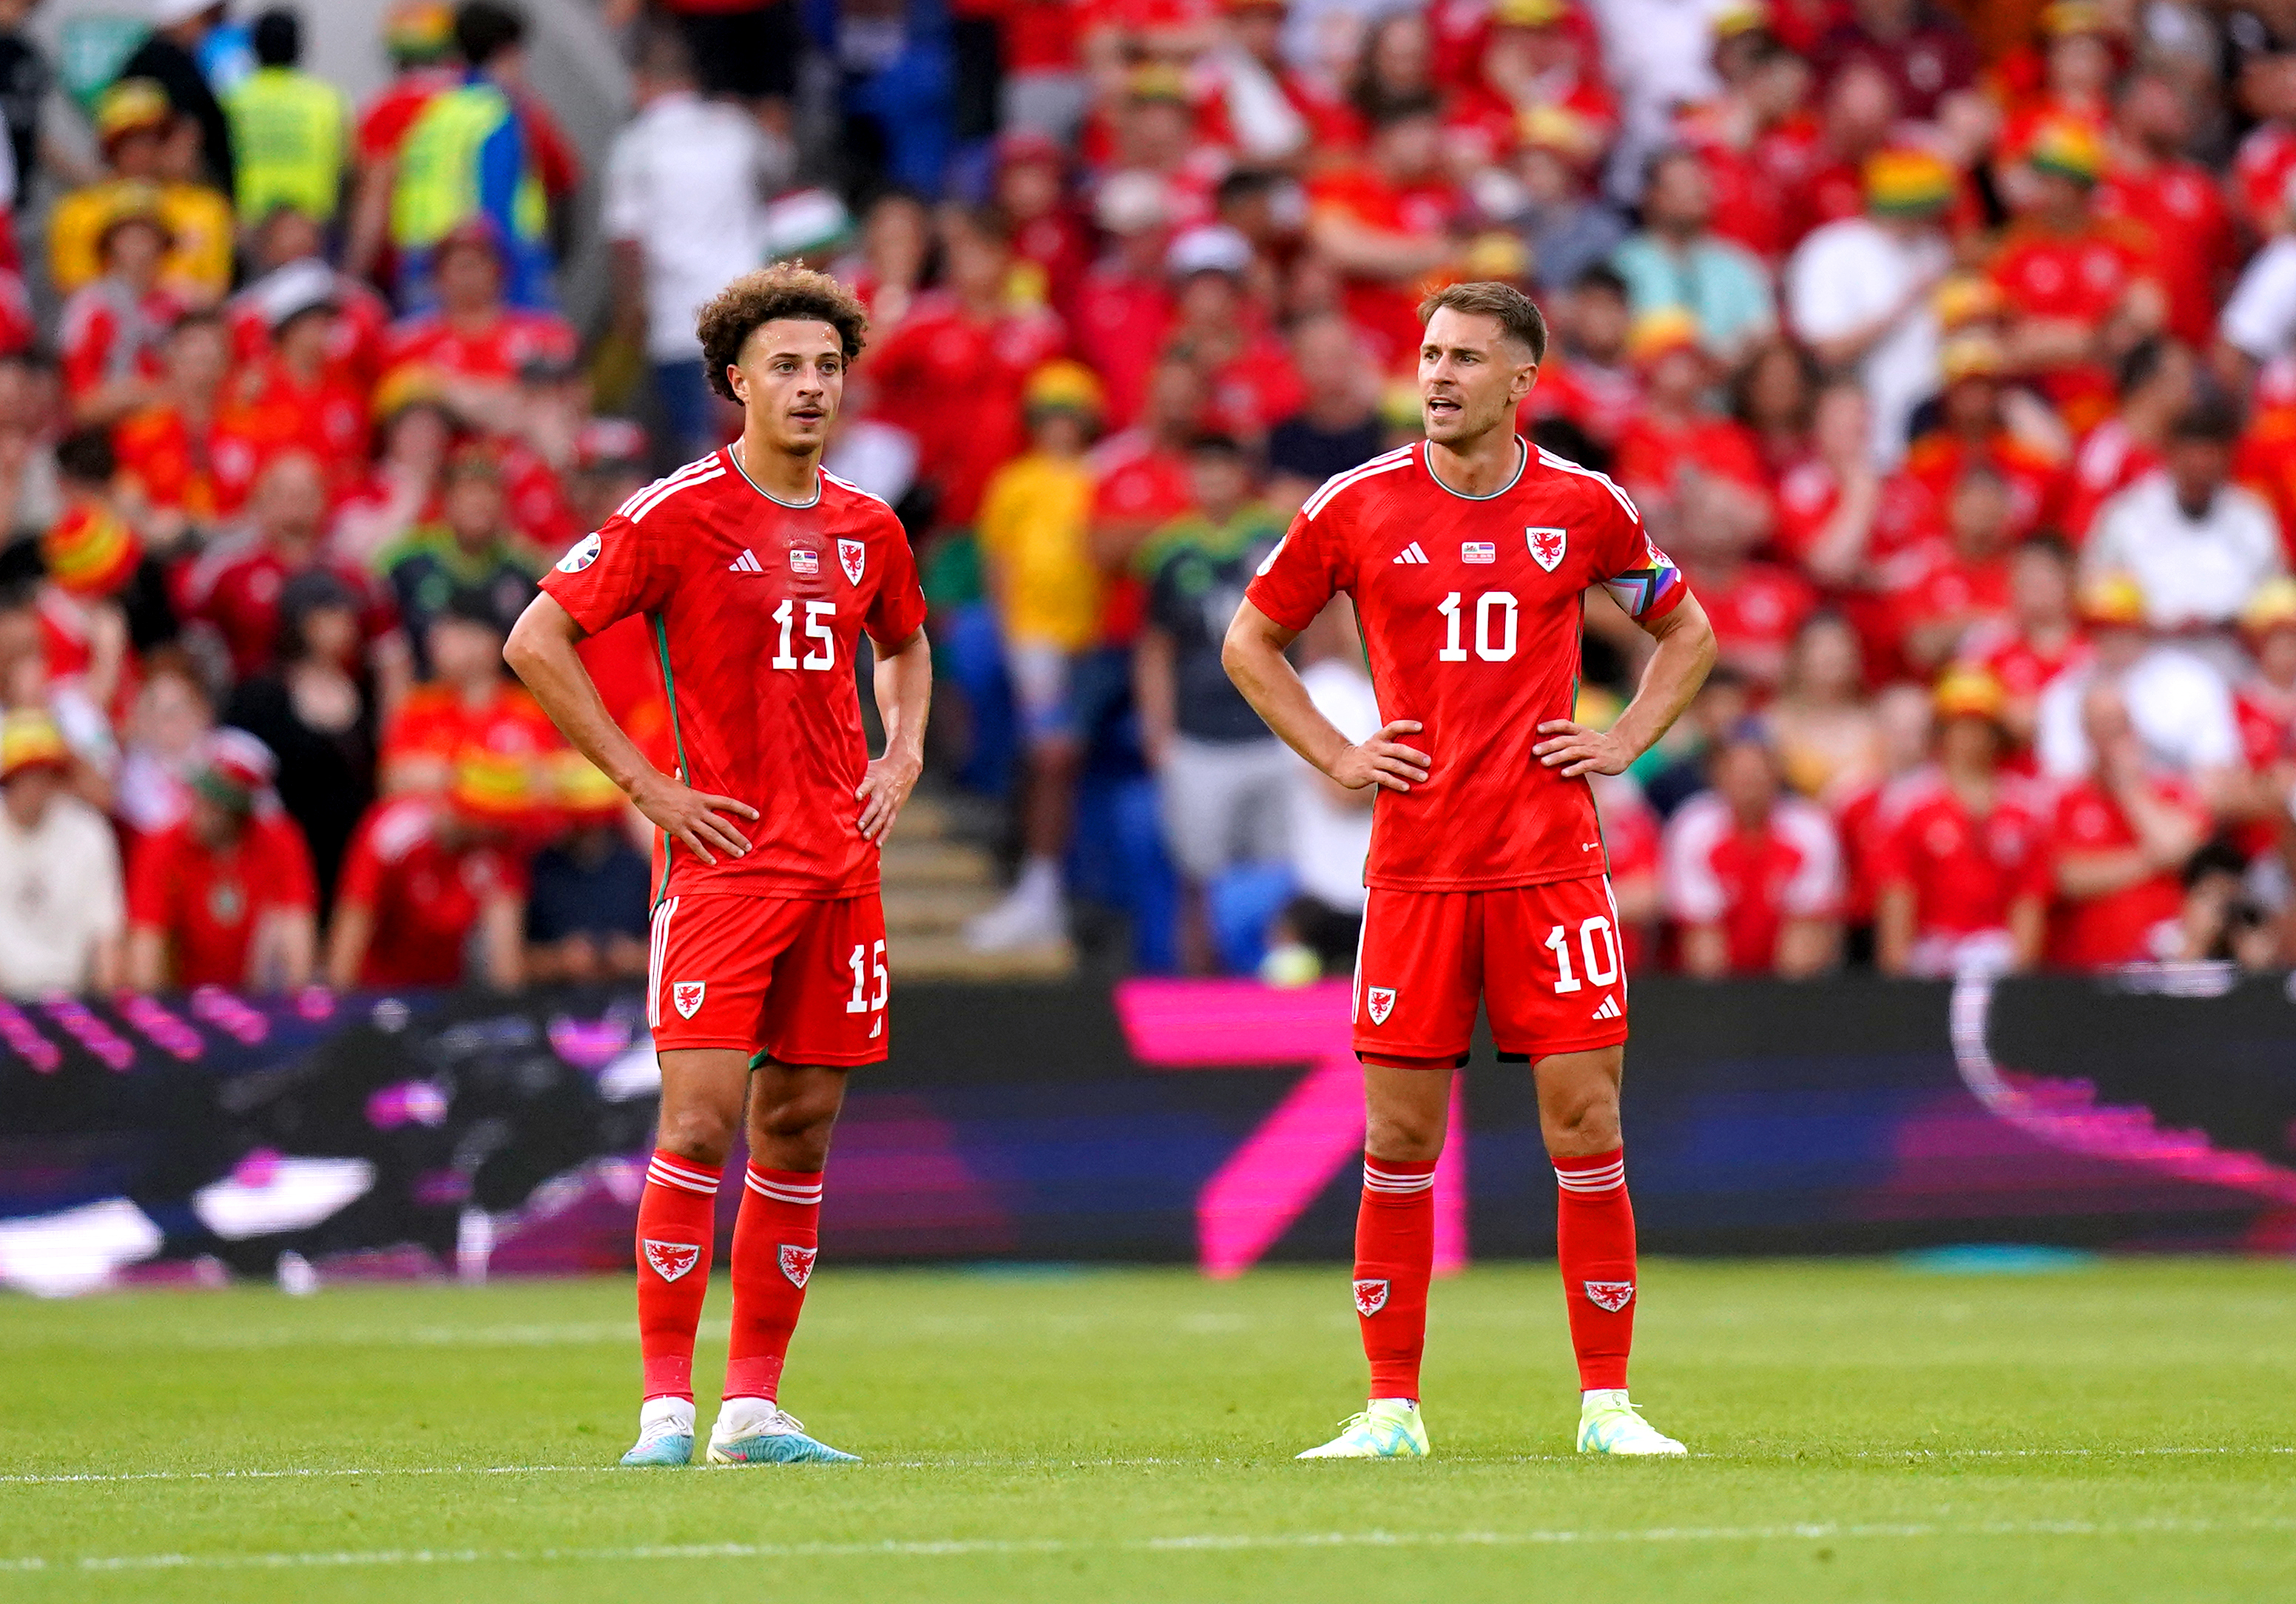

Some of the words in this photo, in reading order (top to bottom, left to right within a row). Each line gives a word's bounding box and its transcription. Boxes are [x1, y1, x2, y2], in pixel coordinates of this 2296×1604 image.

[771, 600, 836, 670] 15
[1437, 592, 1518, 661] 10
[846, 940, 888, 1013] 15
[1544, 916, 1618, 994] 10
